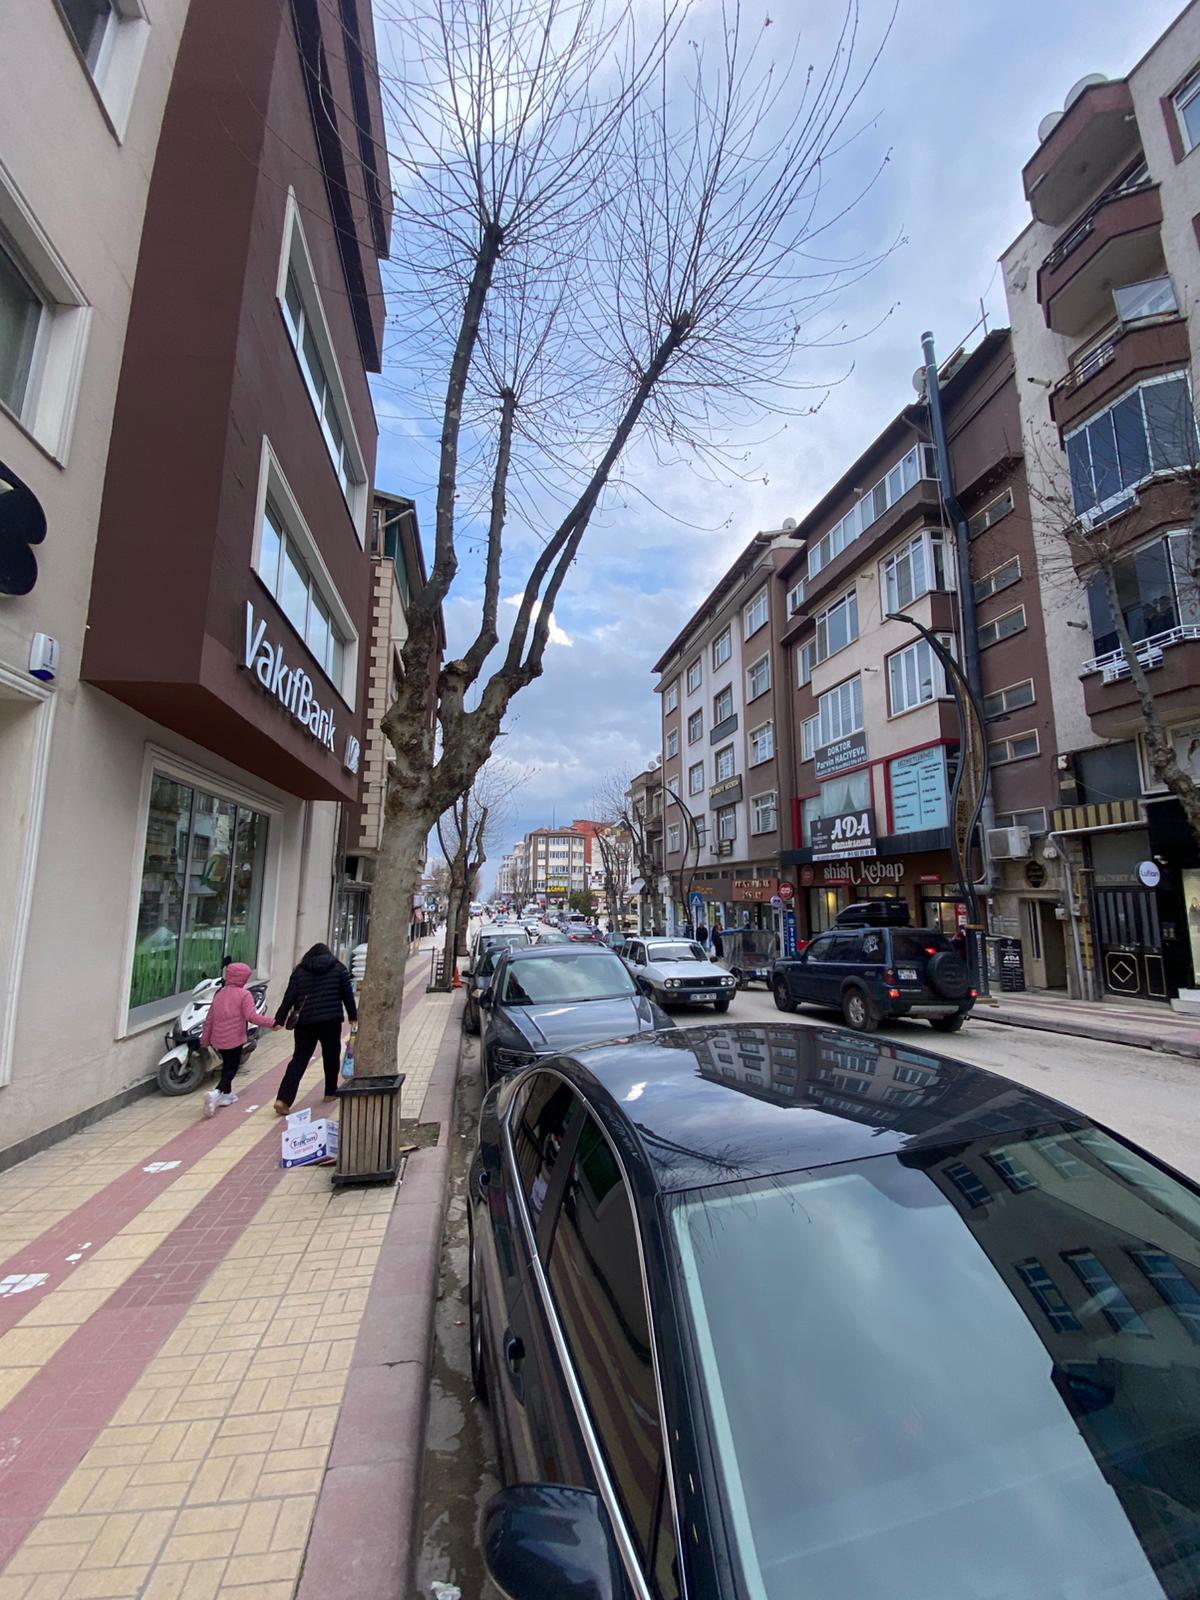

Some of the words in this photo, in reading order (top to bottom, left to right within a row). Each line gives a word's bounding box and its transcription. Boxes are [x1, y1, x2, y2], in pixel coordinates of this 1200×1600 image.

[244, 600, 337, 753] VakıfBank
[827, 740, 851, 756] DOKTOR
[831, 813, 871, 840] ADA
[824, 861, 861, 885] shish
[862, 861, 904, 884] kebap
